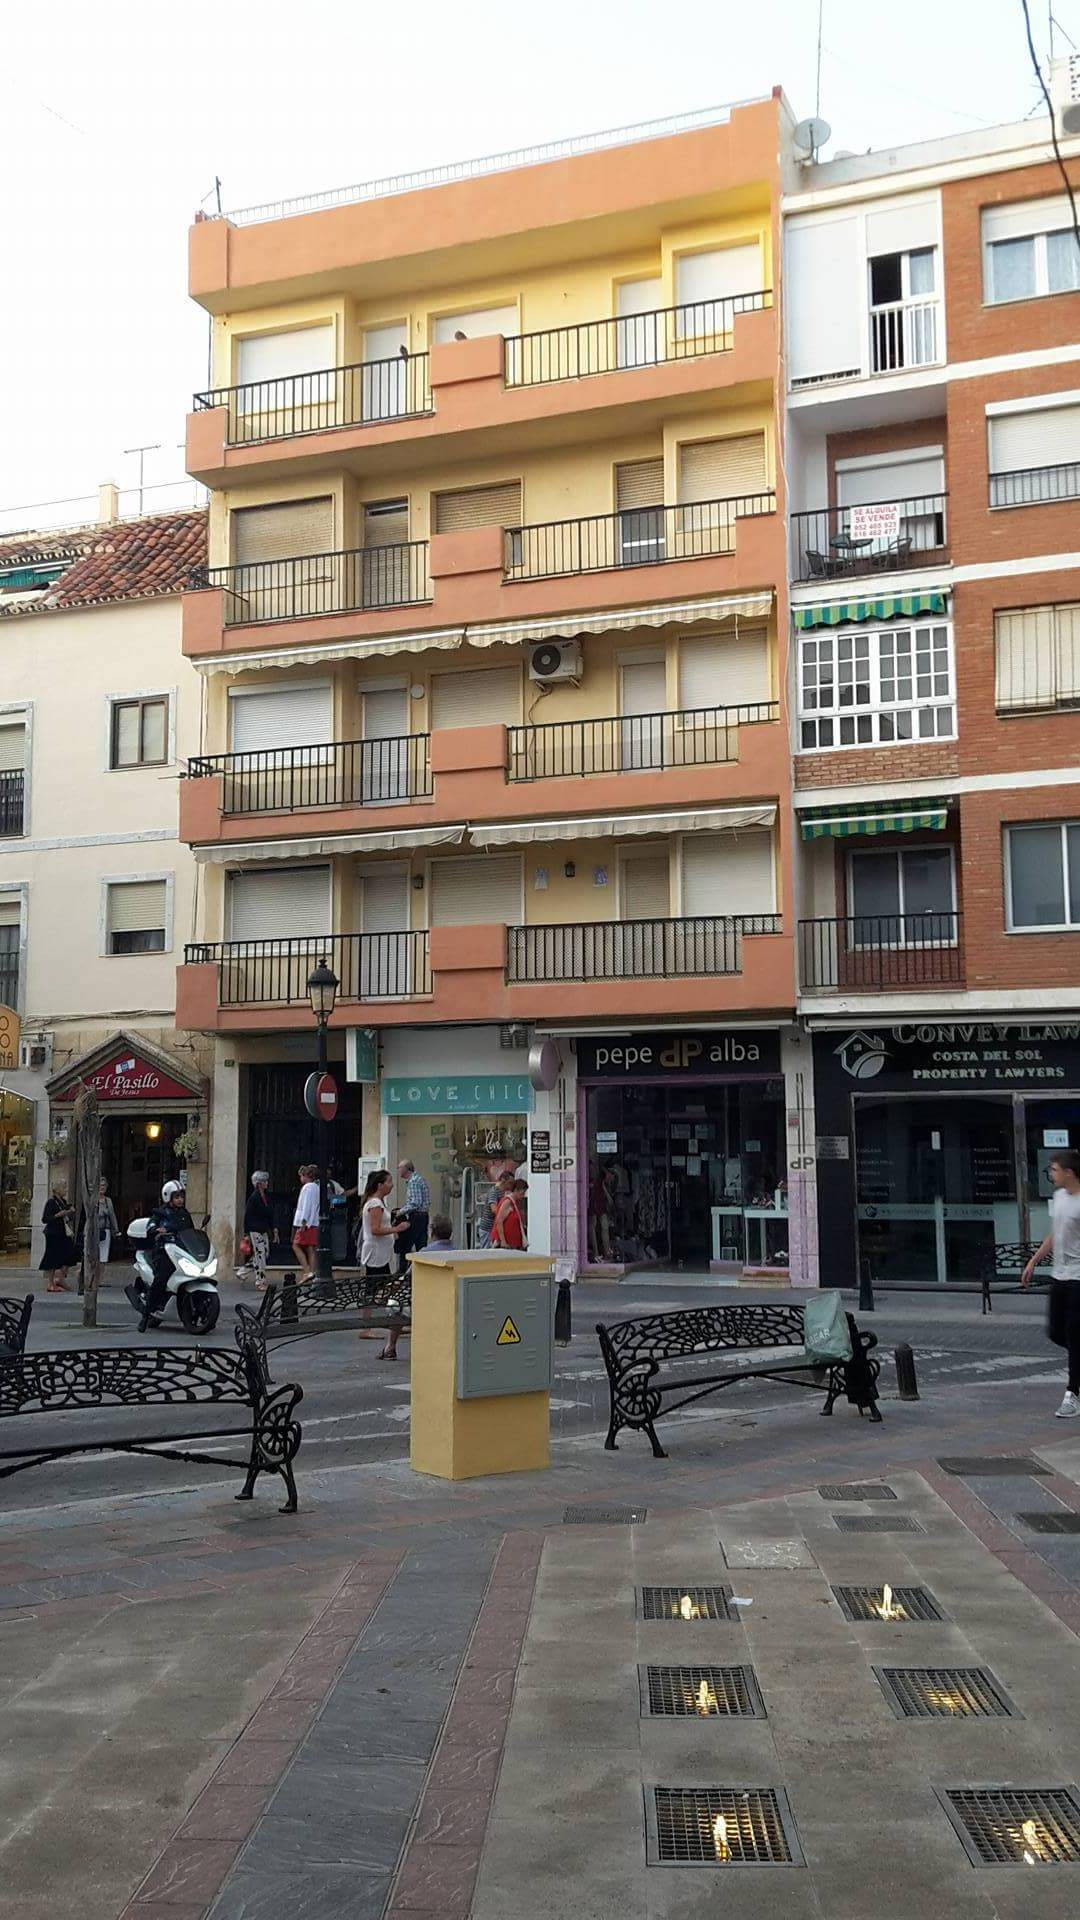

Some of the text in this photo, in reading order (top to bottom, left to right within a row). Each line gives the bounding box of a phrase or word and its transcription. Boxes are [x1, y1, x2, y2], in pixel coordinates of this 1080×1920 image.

[854, 505, 897, 516] SE ALQUILA
[855, 513, 896, 524] SE VENDE
[596, 1047, 652, 1071] pepe
[709, 1037, 760, 1062] alba
[932, 1049, 1042, 1062] COSTA DEL SOL
[912, 1066, 1065, 1080] PROPERTY LAWYERS
[92, 1072, 159, 1090] El Pasillo
[390, 1084, 525, 1102] LOVE CHIC
